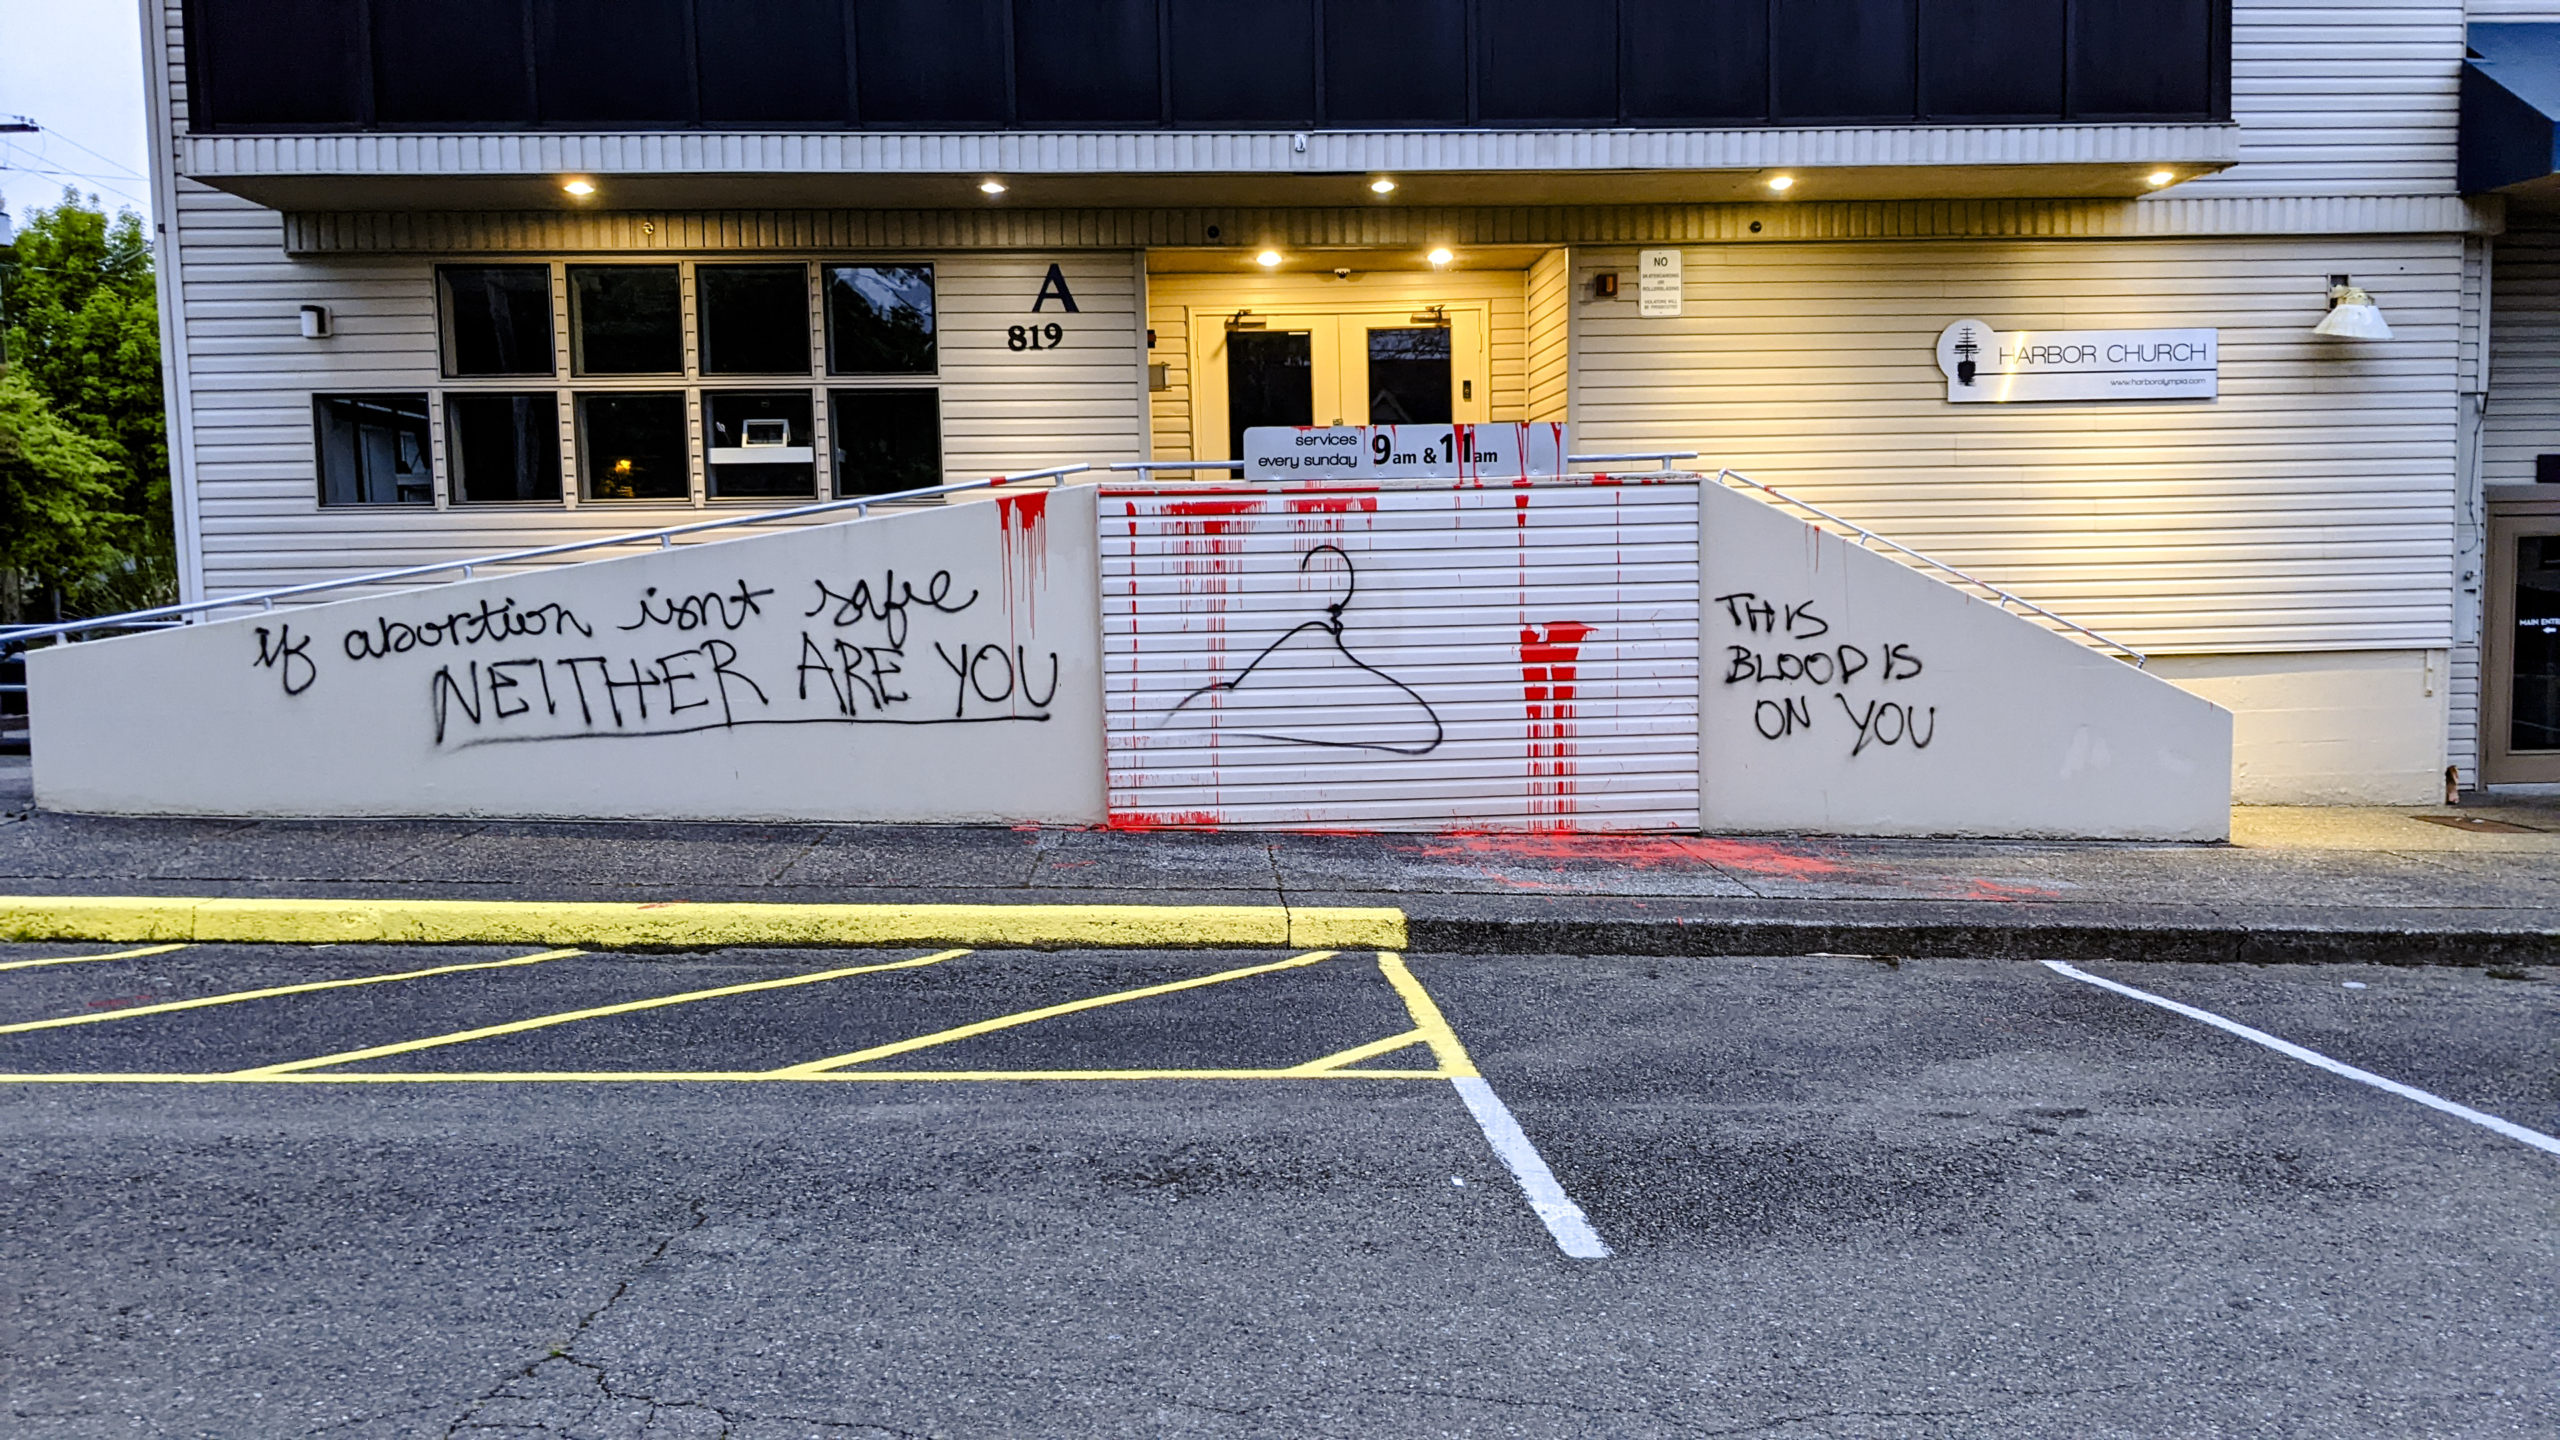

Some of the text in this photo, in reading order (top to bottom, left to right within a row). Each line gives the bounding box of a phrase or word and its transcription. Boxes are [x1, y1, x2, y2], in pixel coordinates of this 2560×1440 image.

[1653, 256, 1669, 267] NO
[1031, 263, 1080, 313] A
[1007, 322, 1064, 352] 819
[1999, 342, 2207, 366] HARBOR CHURCH
[1295, 432, 1358, 447] services
[1371, 433, 1418, 466] 9am
[1422, 447, 1438, 465] &
[1257, 452, 1358, 469] every sunday
[252, 569, 979, 696] if abortion isnt safe
[1714, 592, 1829, 640] THIS
[2519, 618, 2540, 627] MAIN
[1724, 643, 1923, 686] BLOOD IS
[431, 632, 1059, 746] NEITHER ARE YOU
[1754, 692, 1935, 757] ON YOU
